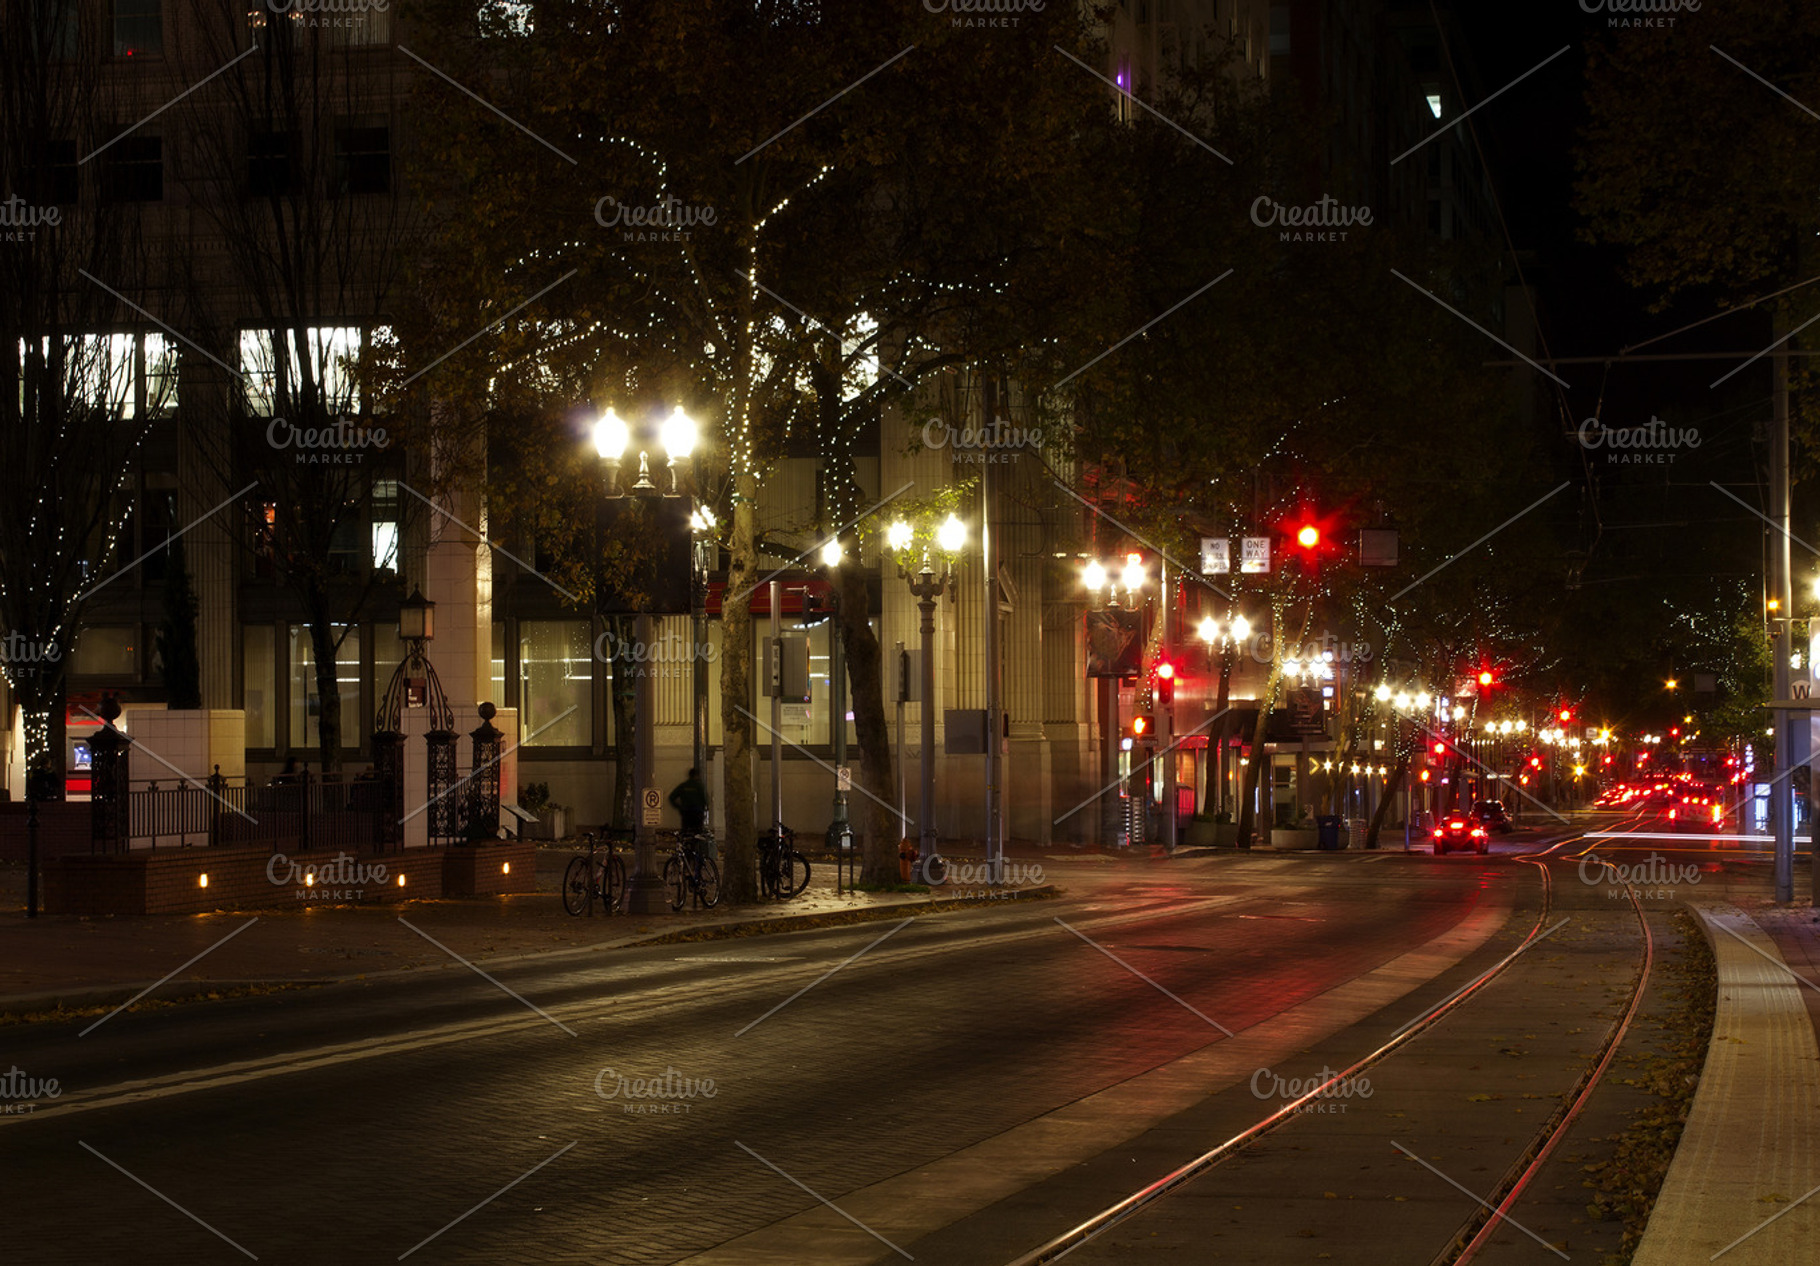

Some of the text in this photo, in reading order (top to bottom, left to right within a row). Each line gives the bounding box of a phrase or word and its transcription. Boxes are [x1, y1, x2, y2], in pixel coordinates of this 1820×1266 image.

[1210, 542, 1220, 550] NO
[1247, 540, 1265, 549] ONE
[1246, 550, 1266, 558] WAY
